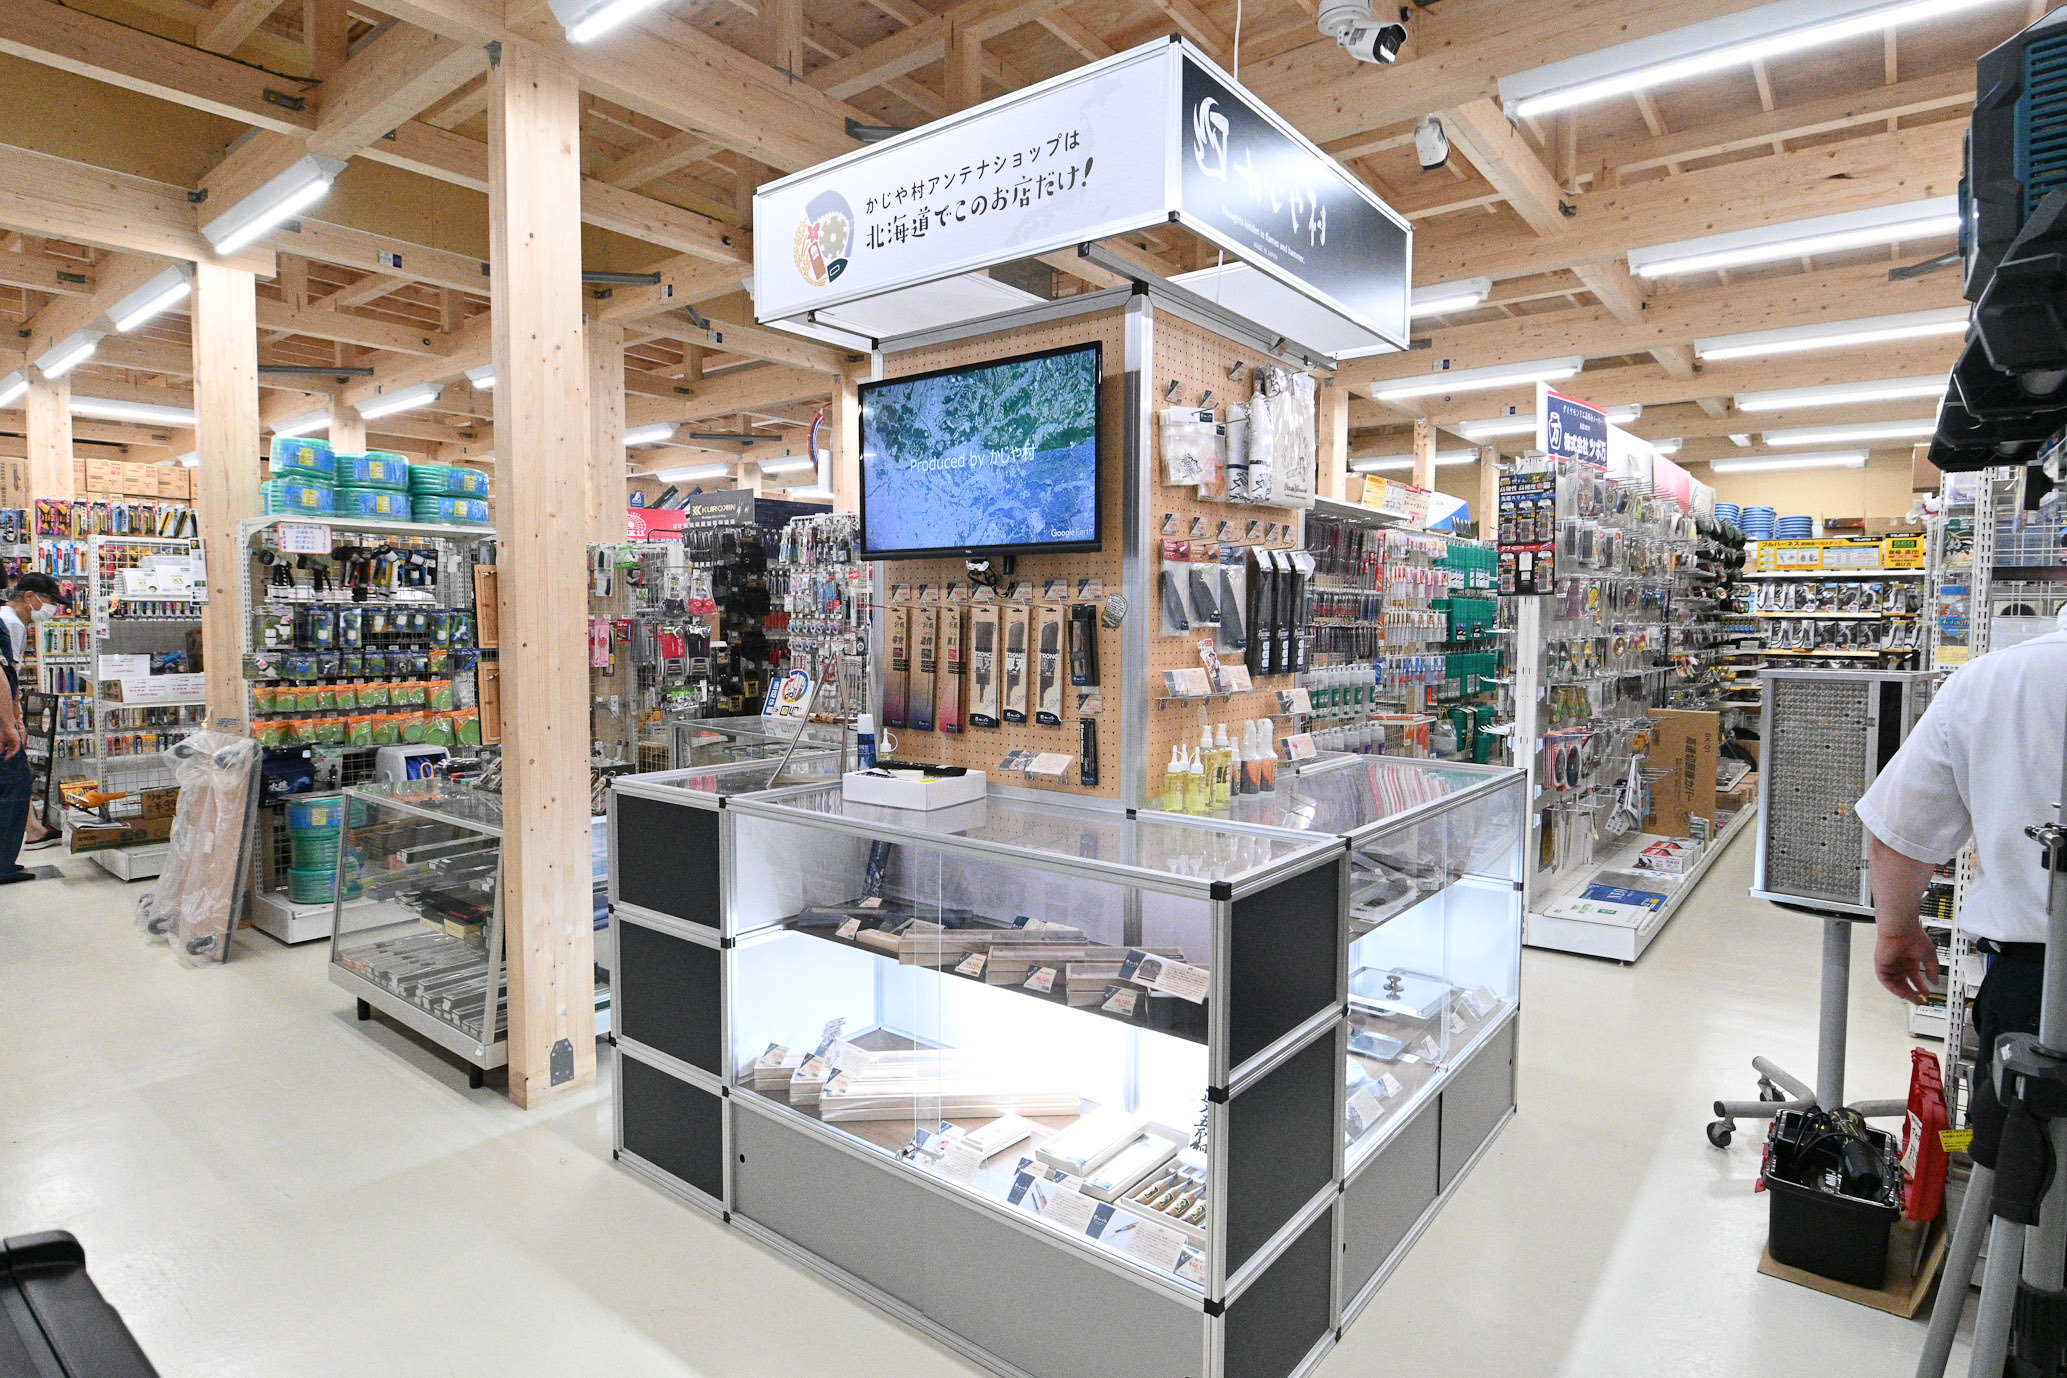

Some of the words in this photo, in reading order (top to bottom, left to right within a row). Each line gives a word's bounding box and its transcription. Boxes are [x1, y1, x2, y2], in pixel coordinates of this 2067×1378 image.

[866, 130, 1080, 214] かじや村アンテナショップは
[910, 453, 966, 473] Produced
[970, 451, 985, 468] by
[989, 443, 1036, 466] かじや村
[701, 503, 736, 514] KUROKIN
[1051, 528, 1075, 538] Google
[1075, 526, 1093, 537] Earth
[1761, 540, 1800, 548] フルハーネス
